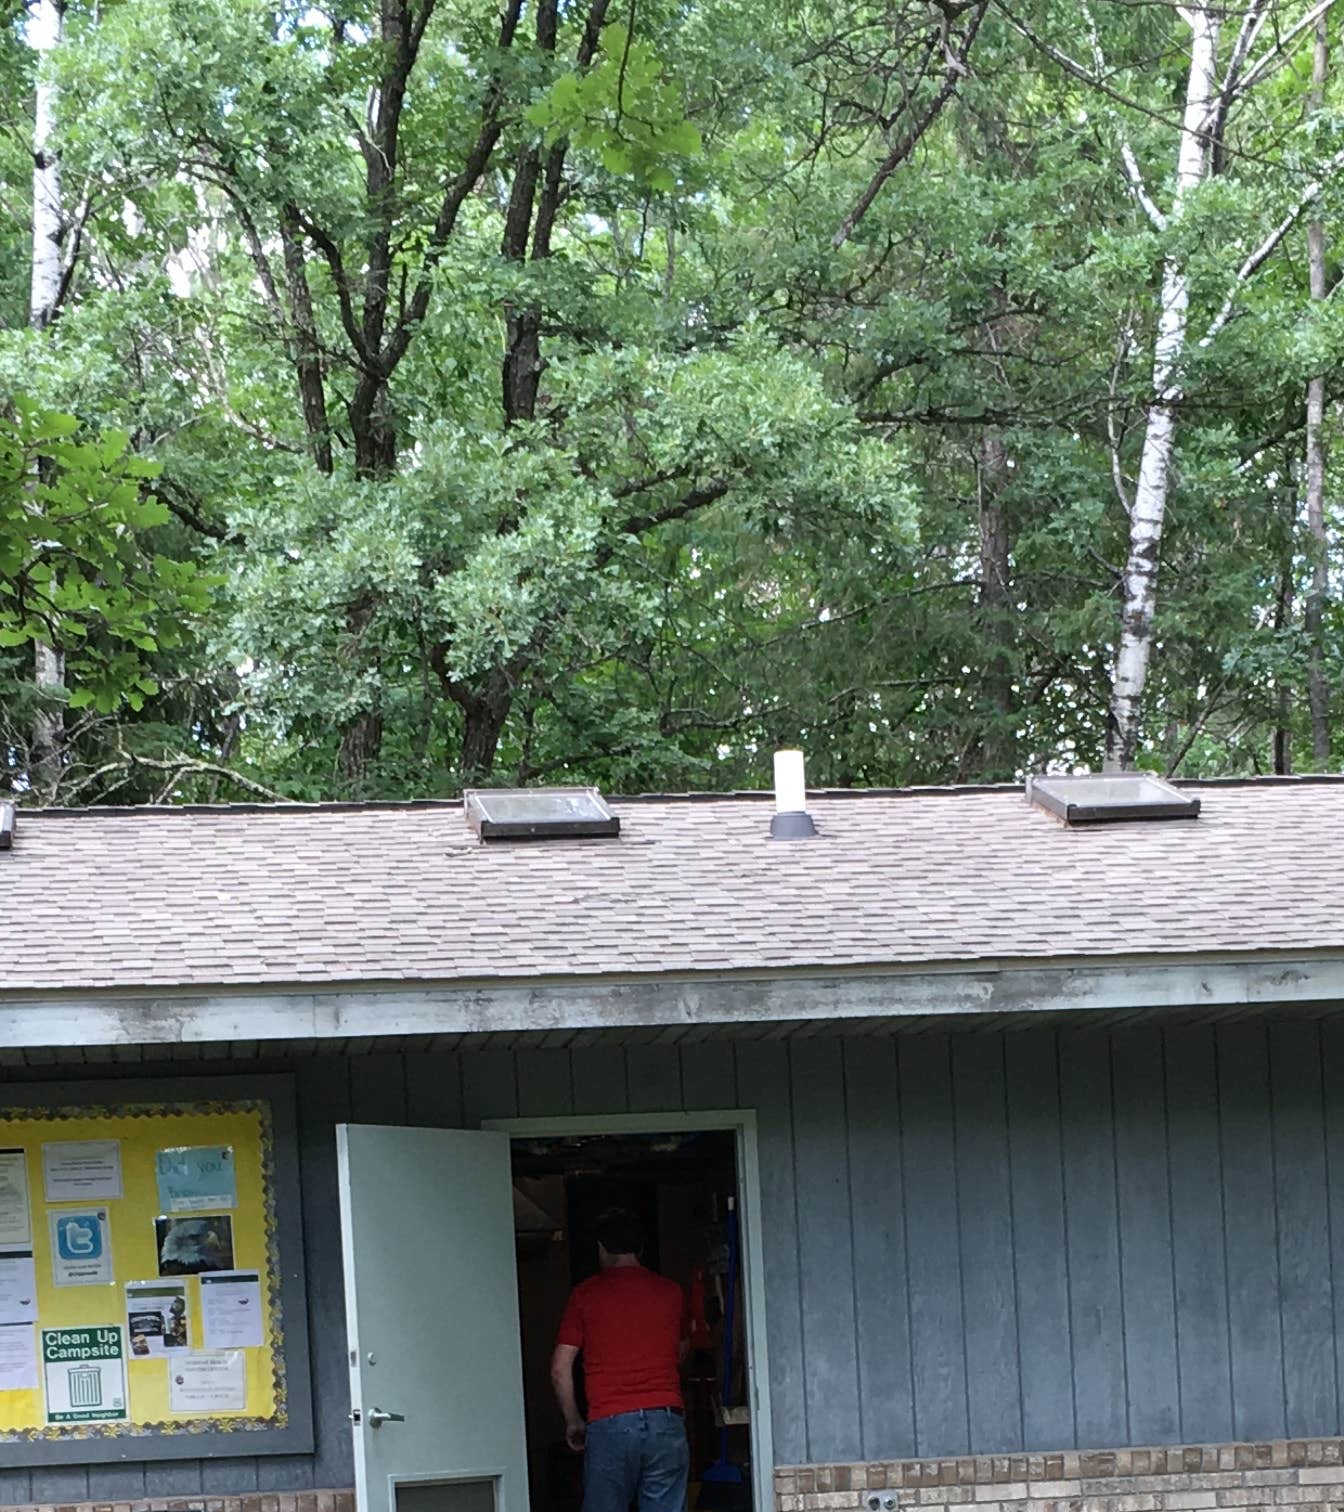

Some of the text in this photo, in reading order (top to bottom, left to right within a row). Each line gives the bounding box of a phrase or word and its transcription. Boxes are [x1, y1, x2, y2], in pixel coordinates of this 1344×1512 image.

[45, 1329, 118, 1345] Clean Up
[46, 1343, 119, 1359] Campsite
